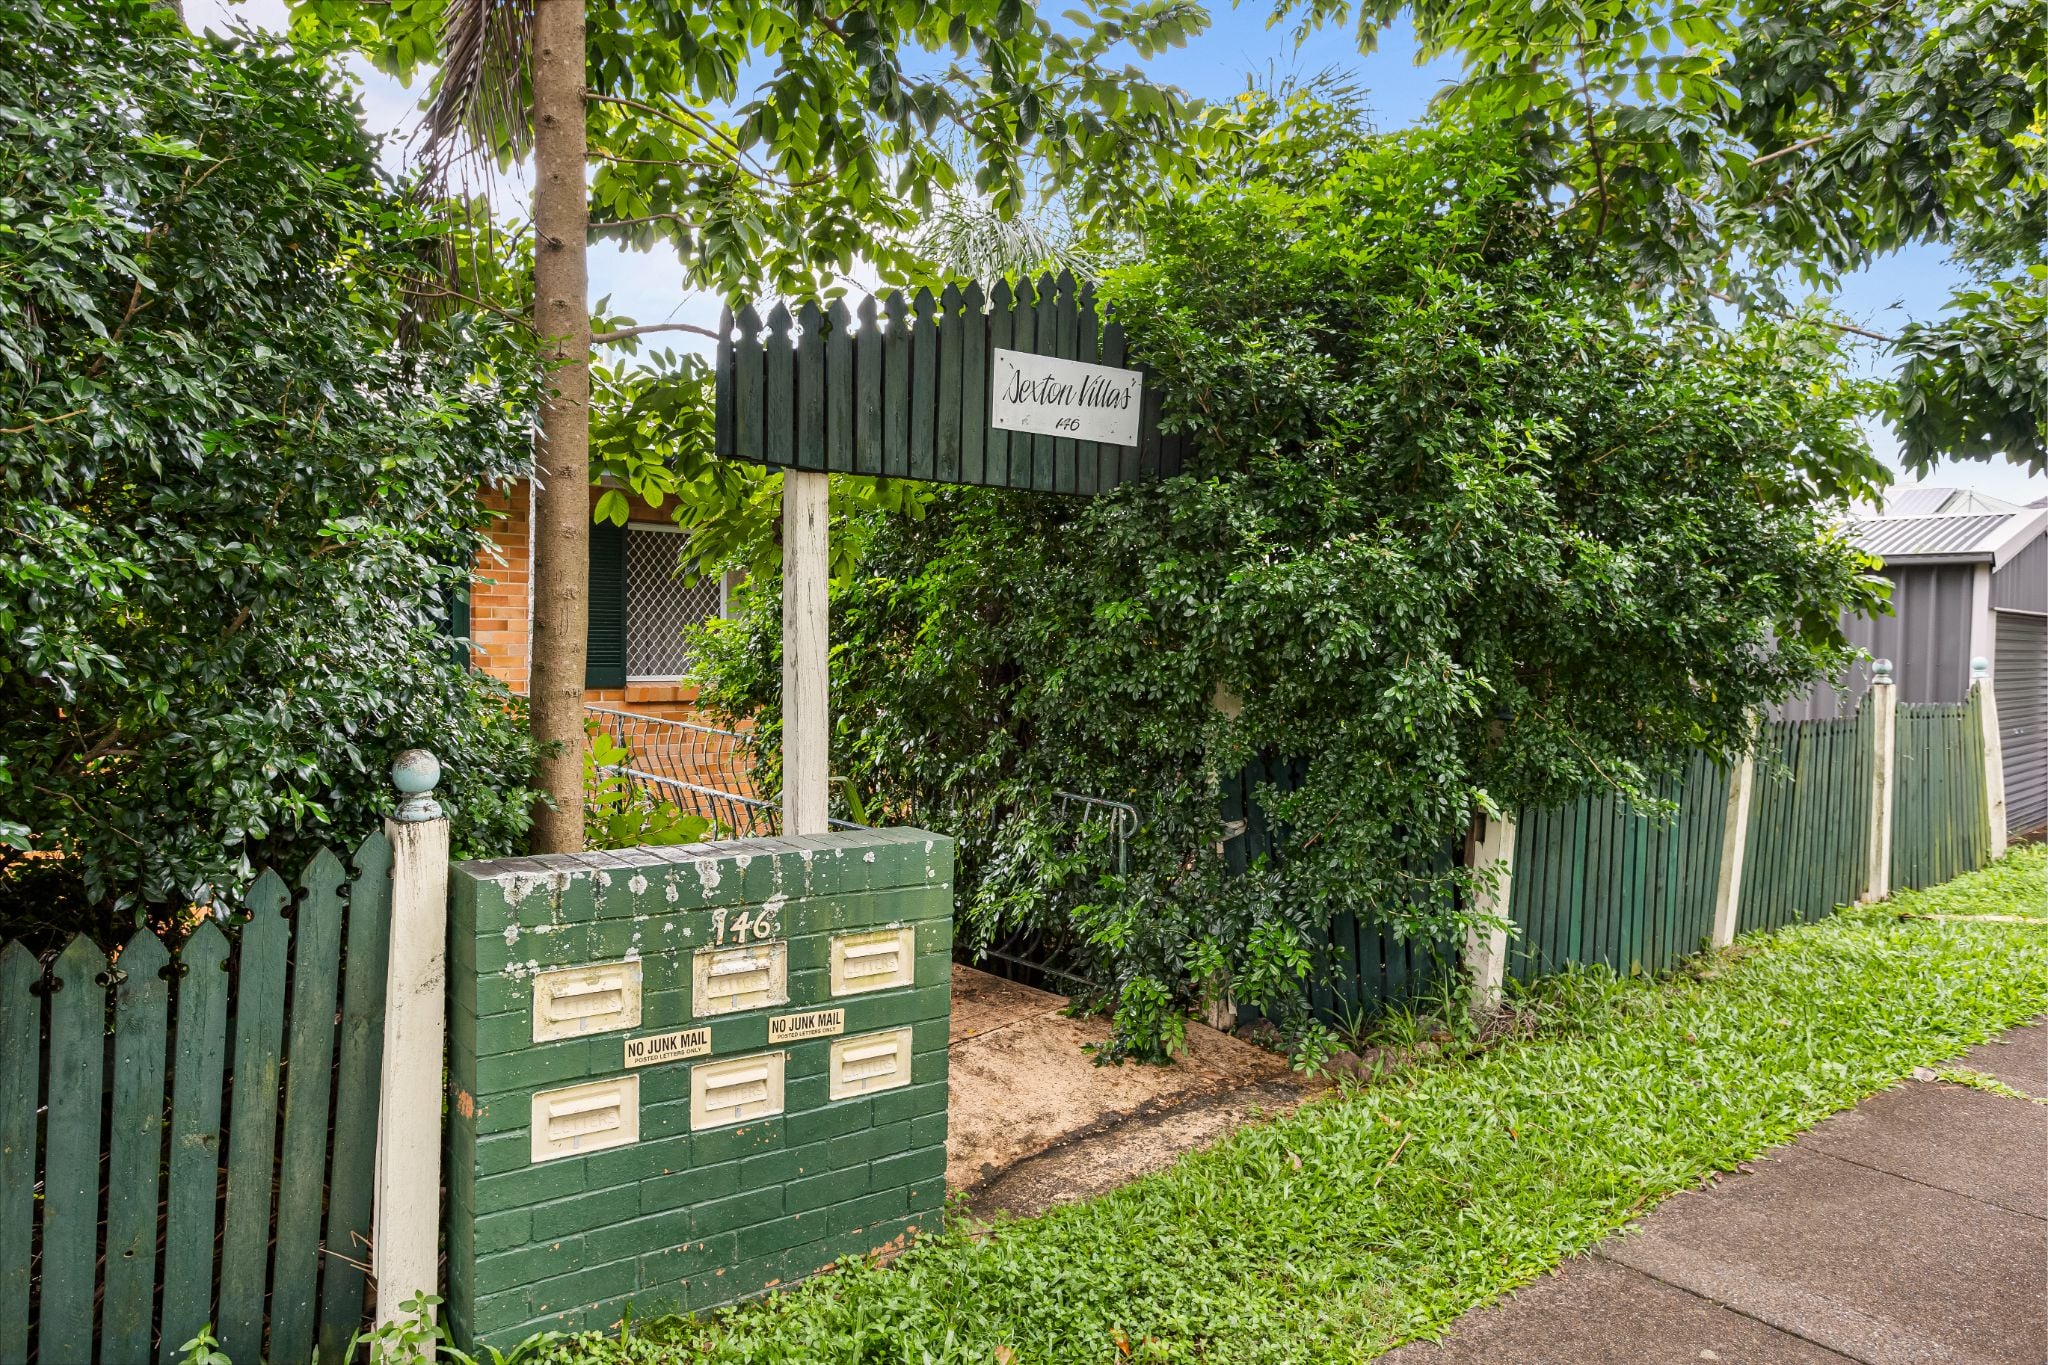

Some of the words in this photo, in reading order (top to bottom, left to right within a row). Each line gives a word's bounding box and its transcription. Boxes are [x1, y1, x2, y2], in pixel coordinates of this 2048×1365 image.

[1055, 417, 1080, 431] 146
[712, 908, 772, 945] 146
[772, 1019, 786, 1034] NO
[789, 1015, 815, 1032] JUNK
[818, 1011, 841, 1027] MAIL
[799, 1029, 821, 1037] LETTERS
[628, 1041, 644, 1057] NO
[647, 1036, 677, 1053] JUNK
[680, 1031, 707, 1048] MAIL
[634, 1055, 659, 1063] POSTED
[660, 1051, 685, 1059] LETTERS
[687, 1047, 702, 1055] ONLY
